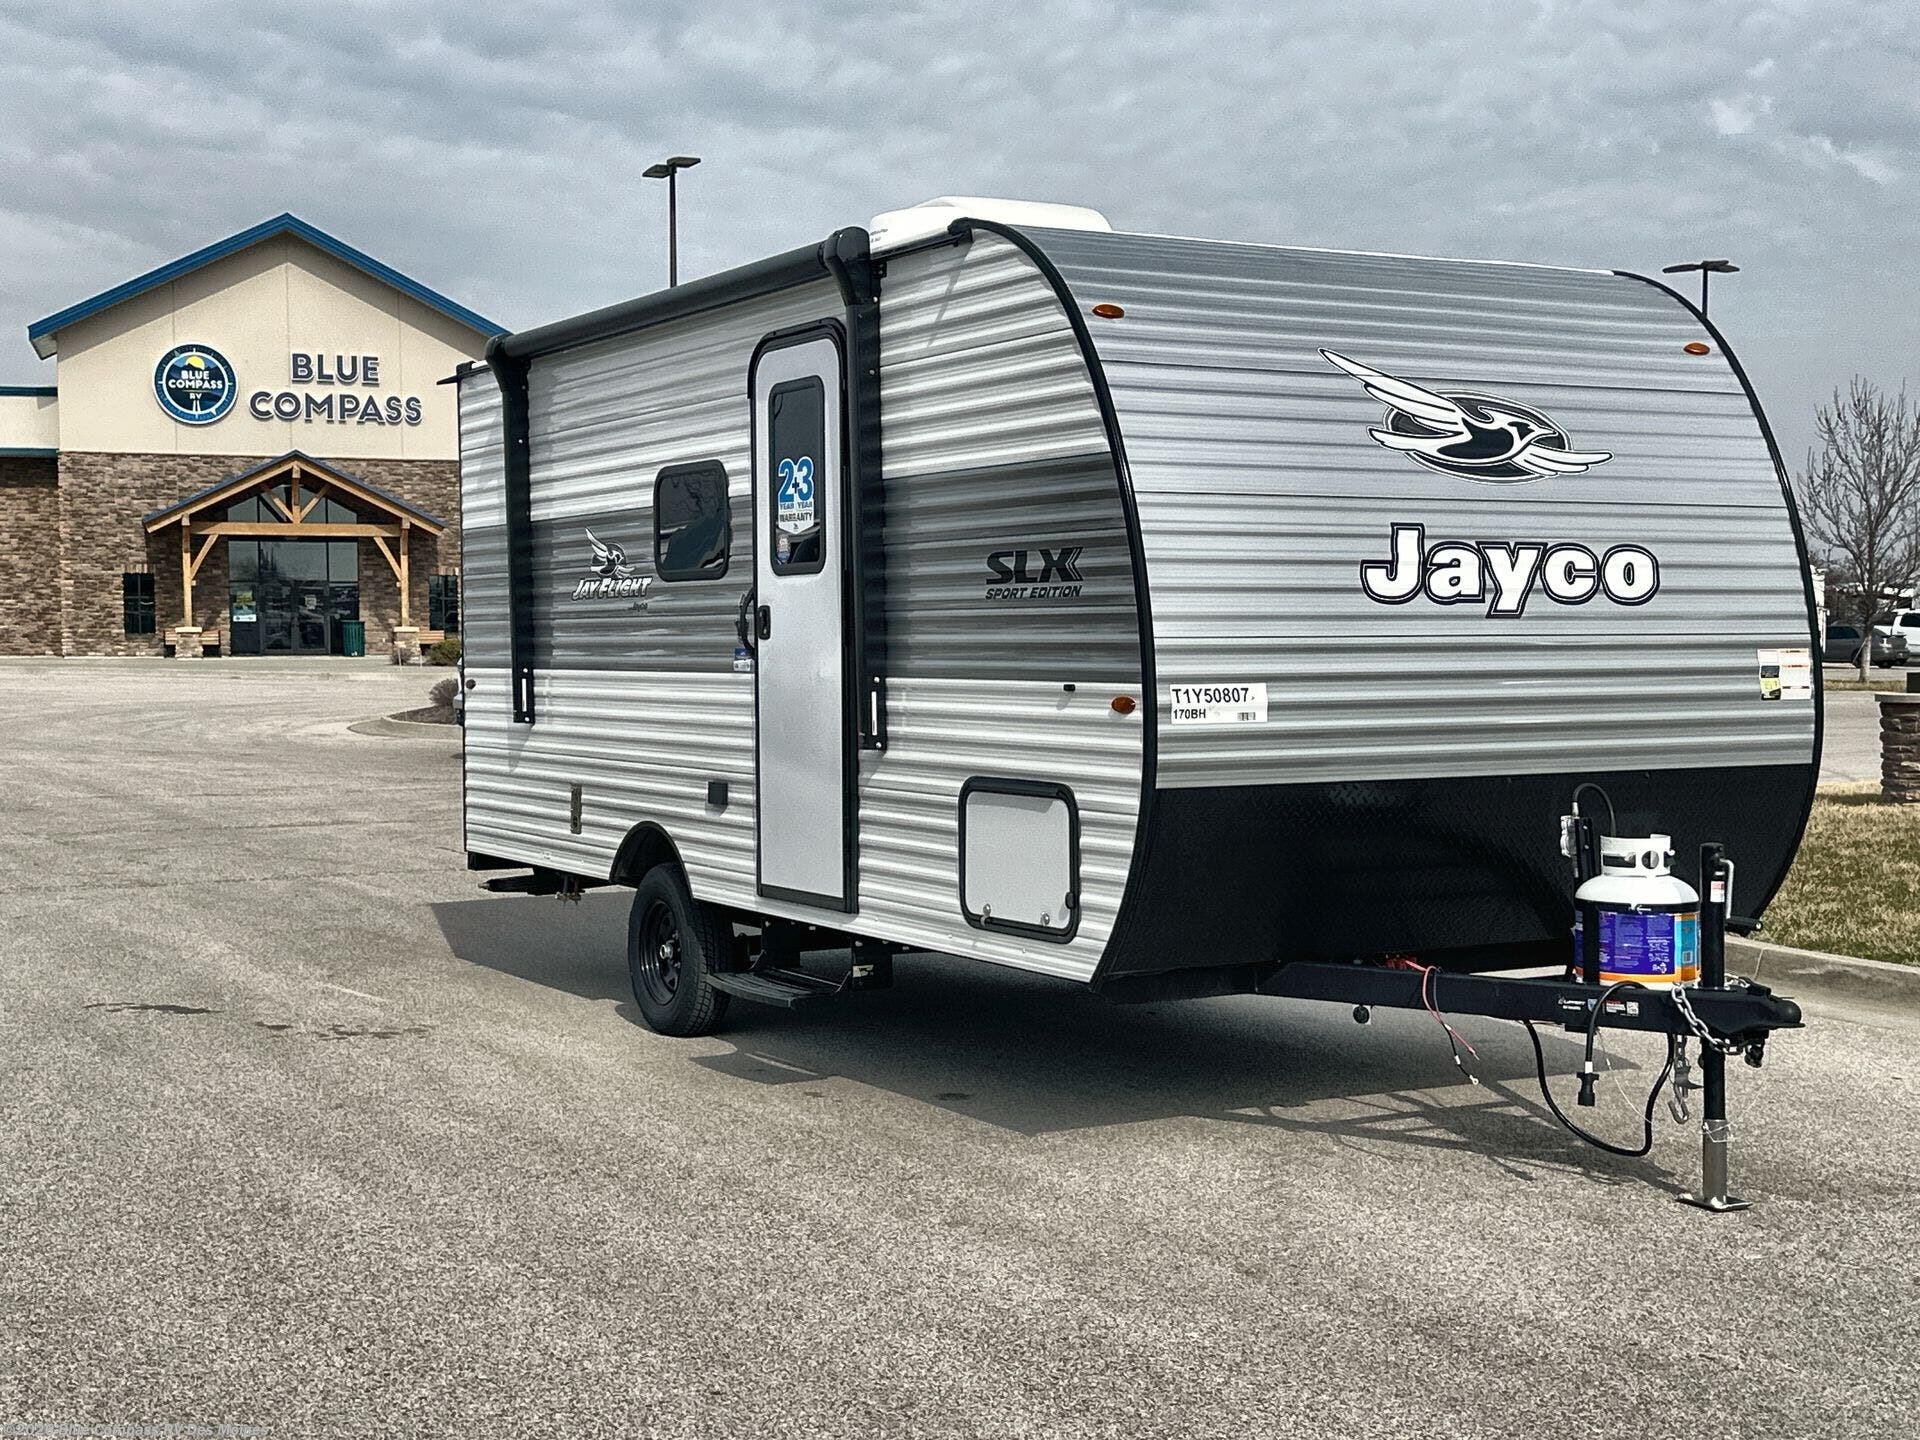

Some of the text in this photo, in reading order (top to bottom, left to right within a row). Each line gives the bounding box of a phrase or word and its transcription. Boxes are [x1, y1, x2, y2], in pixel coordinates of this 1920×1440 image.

[181, 370, 210, 380] BLUE
[291, 352, 380, 386] BLUE
[168, 379, 223, 389] COMPASS
[189, 392, 202, 400] RV
[249, 391, 423, 426] COMPASS
[779, 512, 813, 523] WARRANTY
[986, 547, 1084, 585] SLX
[1360, 522, 1660, 619] Jayco
[985, 585, 1083, 600] SPORT EDITION
[1172, 687, 1249, 704] T1Y50807
[1173, 708, 1206, 719] 170BH
